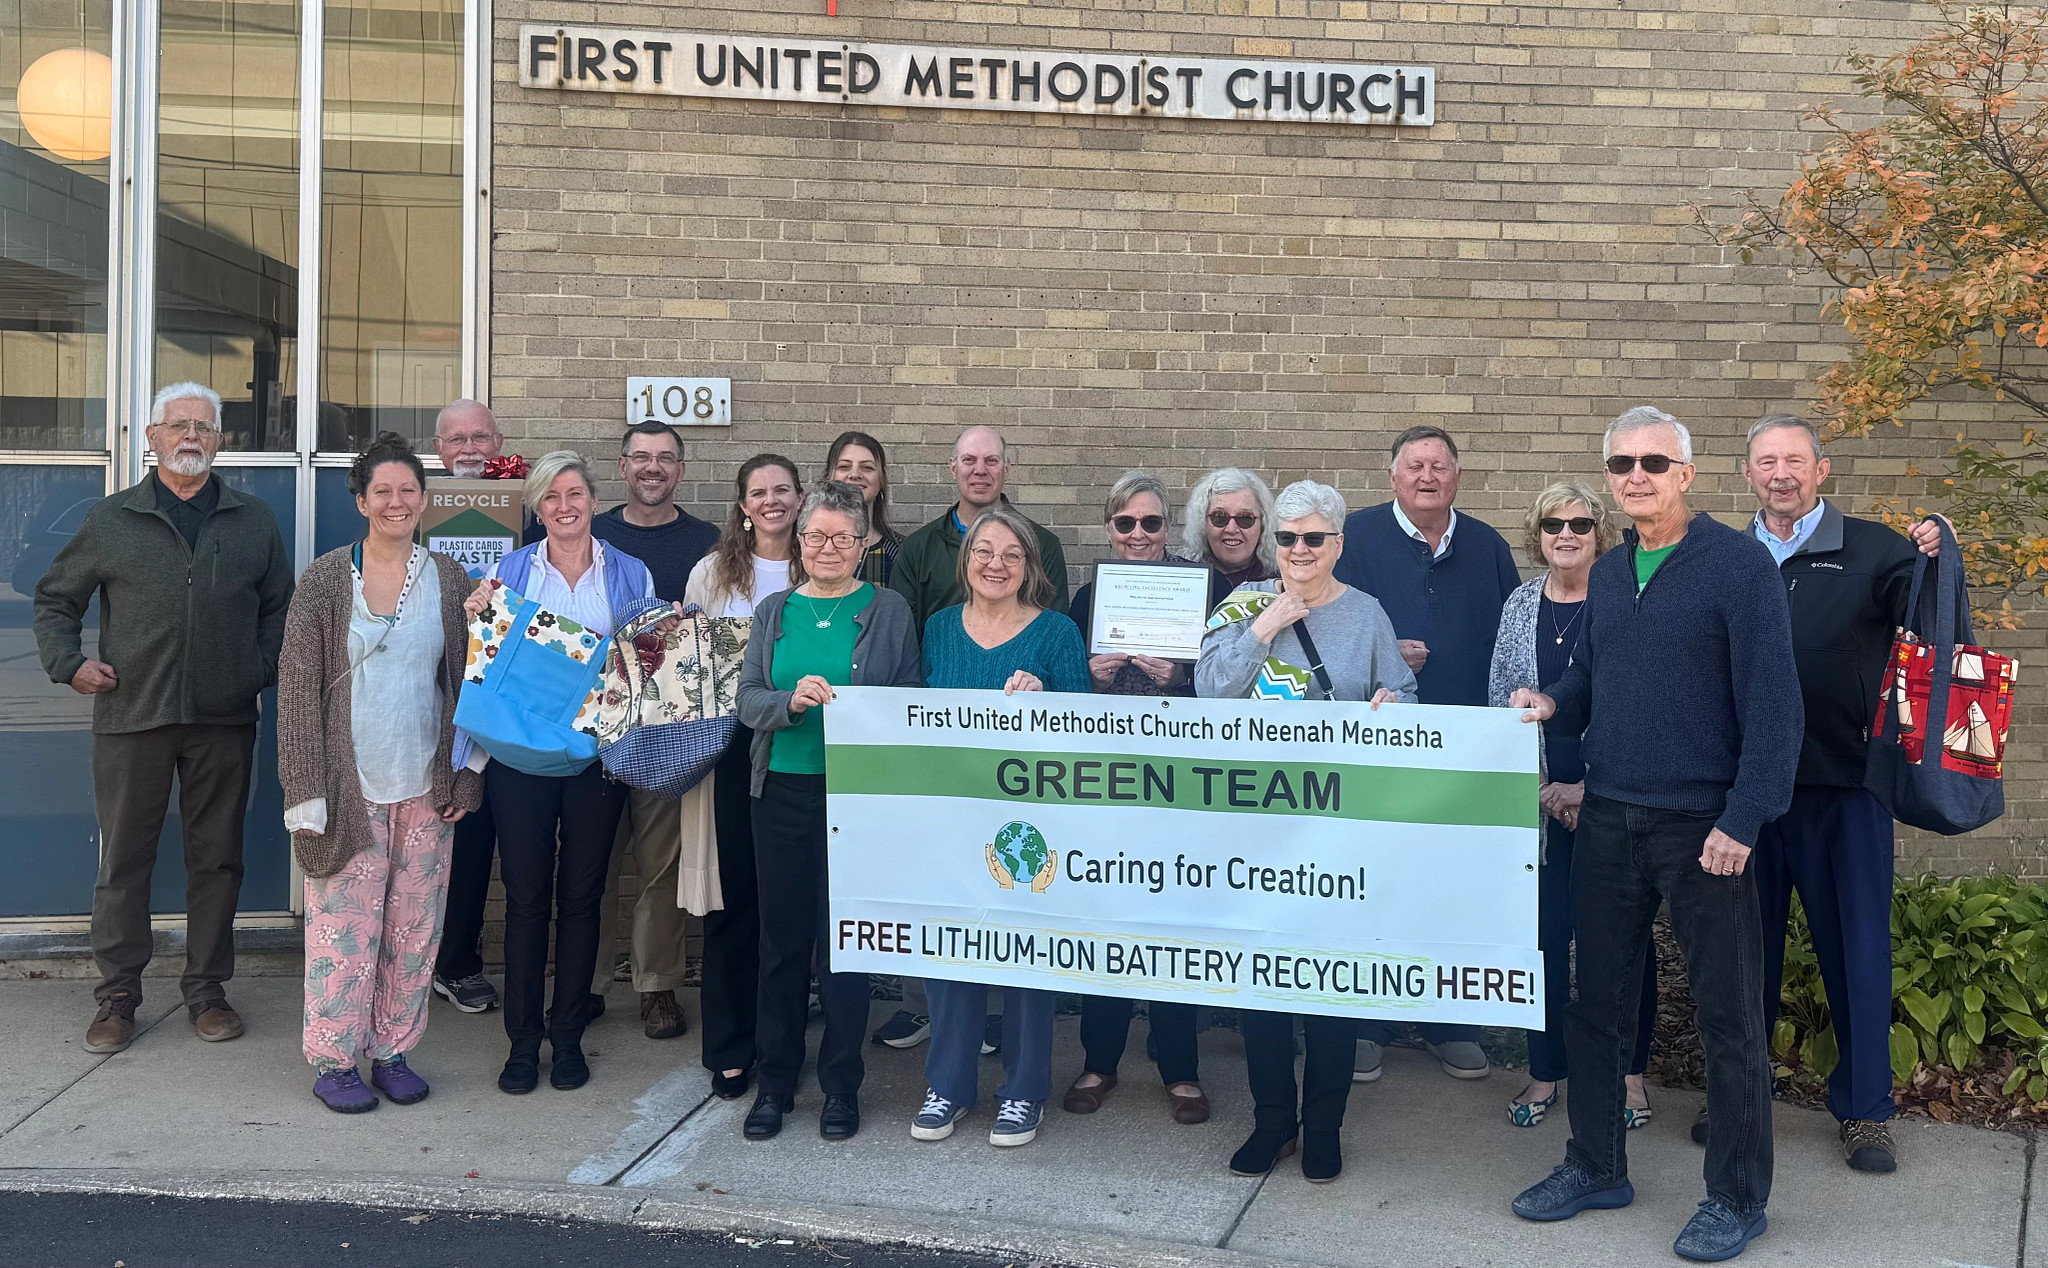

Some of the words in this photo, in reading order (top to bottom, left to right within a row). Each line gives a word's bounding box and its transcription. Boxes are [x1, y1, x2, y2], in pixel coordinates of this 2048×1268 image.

[529, 35, 672, 84] FIRST
[696, 43, 881, 94] UNITED
[904, 54, 1203, 108] METHODIST
[1226, 68, 1425, 115] CHURCH
[641, 384, 714, 419] 108
[433, 494, 510, 507] RECYCLE
[439, 540, 474, 551] PLASTIC
[475, 541, 503, 550] CARDS
[1816, 562, 1843, 570] Columbia
[907, 705, 952, 728] First
[957, 706, 1022, 732] United
[1030, 709, 1134, 736] Methodist
[1140, 713, 1214, 740] Church
[1221, 717, 1242, 741] of
[1249, 718, 1334, 743] Neenah
[1342, 720, 1443, 749] Menasha
[996, 758, 1175, 803] GREEN
[1191, 766, 1341, 812] TEAM
[1066, 850, 1164, 893] Caring
[1174, 854, 1217, 888] for
[1227, 857, 1365, 900] Creation!
[838, 920, 912, 954] FREE
[921, 925, 1095, 972] LITHIUM-ION
[1106, 942, 1243, 984] BATTERY
[1252, 953, 1425, 998] RECYCLING
[1436, 965, 1535, 1005] HERE!
